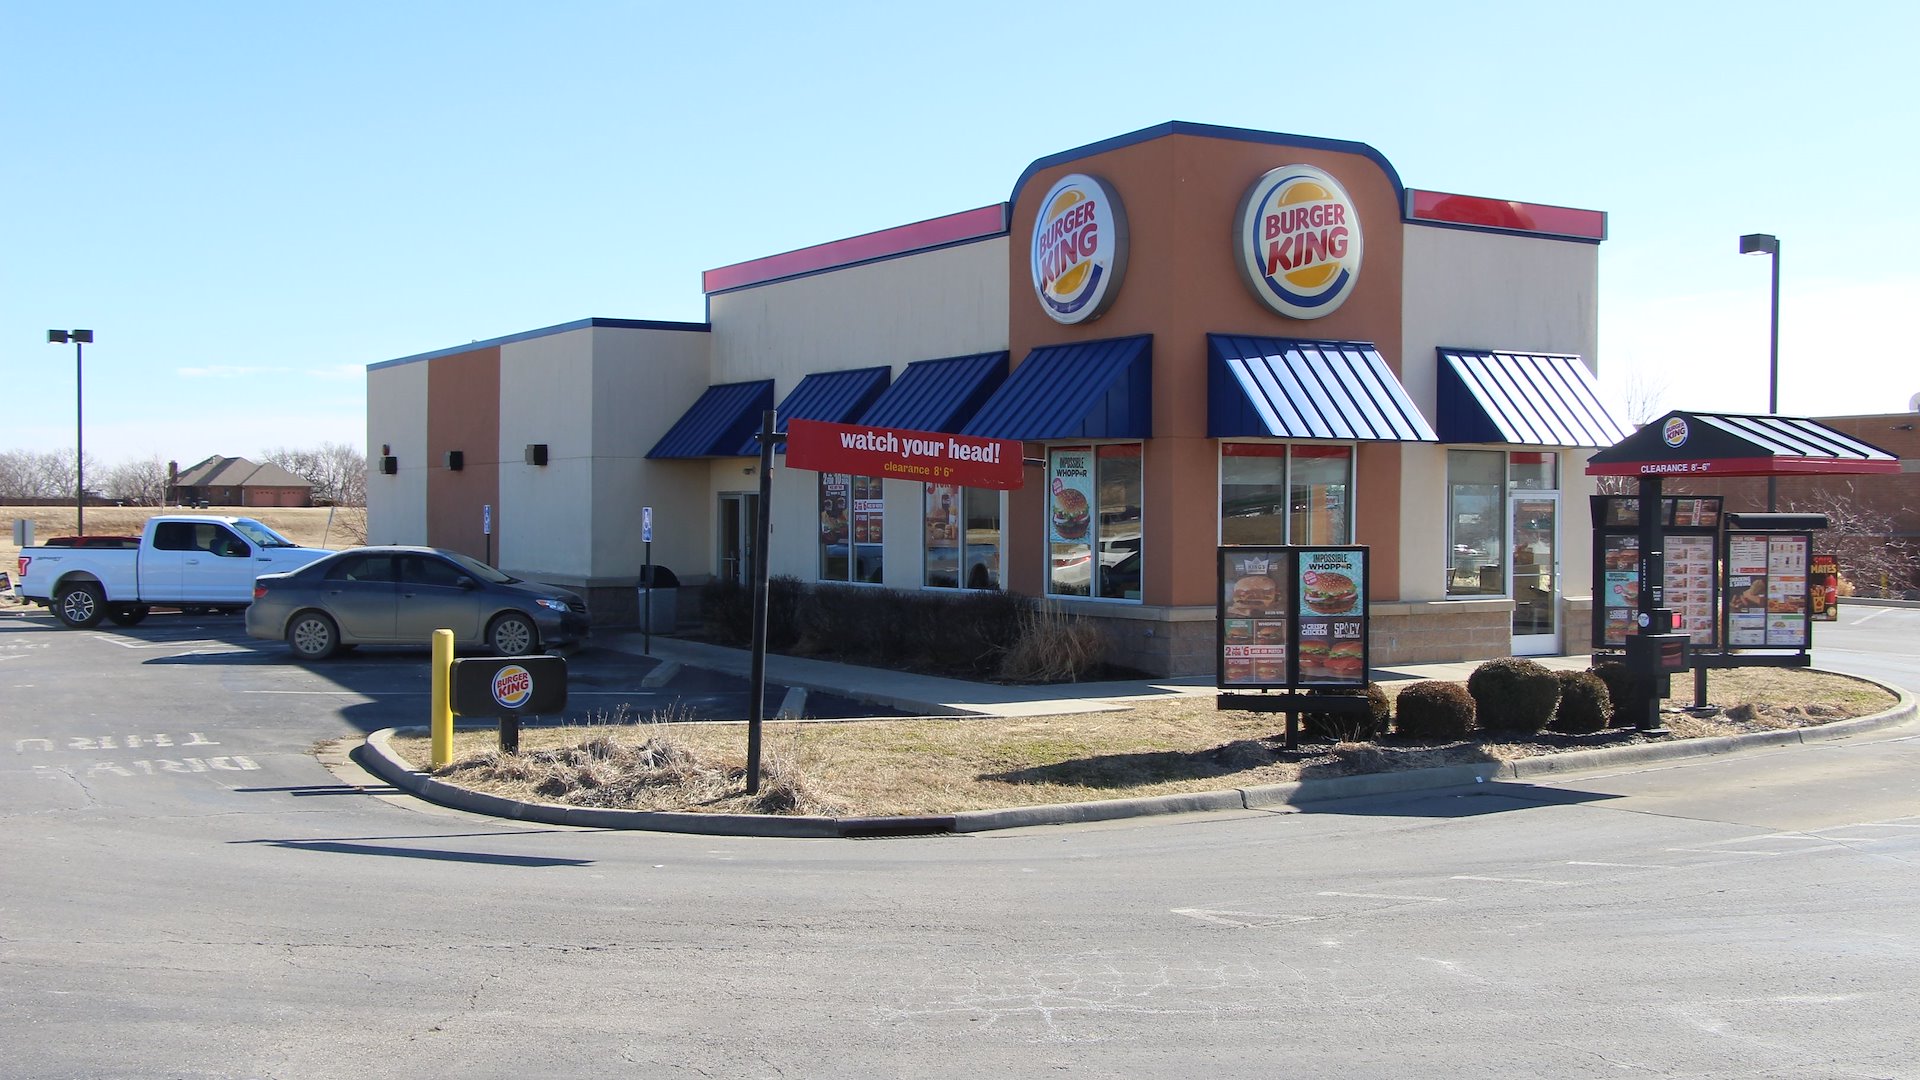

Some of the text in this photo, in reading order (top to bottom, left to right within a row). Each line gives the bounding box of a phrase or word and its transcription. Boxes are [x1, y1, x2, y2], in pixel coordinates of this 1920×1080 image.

[1266, 203, 1346, 240] BURGER
[1040, 201, 1095, 258] BURGER
[1041, 223, 1098, 292] KING
[1266, 226, 1349, 276] KING
[1666, 422, 1685, 433] BURGER
[1667, 428, 1686, 440] KING
[840, 431, 1000, 464] watch your head!
[884, 461, 930, 475] clearance
[1640, 464, 1688, 474] CLEARANCE
[1313, 554, 1348, 563] IMPOSSIBLE
[1811, 565, 1837, 573] MATES
[1225, 646, 1232, 656] 2
[497, 672, 528, 688] BURGER
[498, 680, 529, 699] KING
